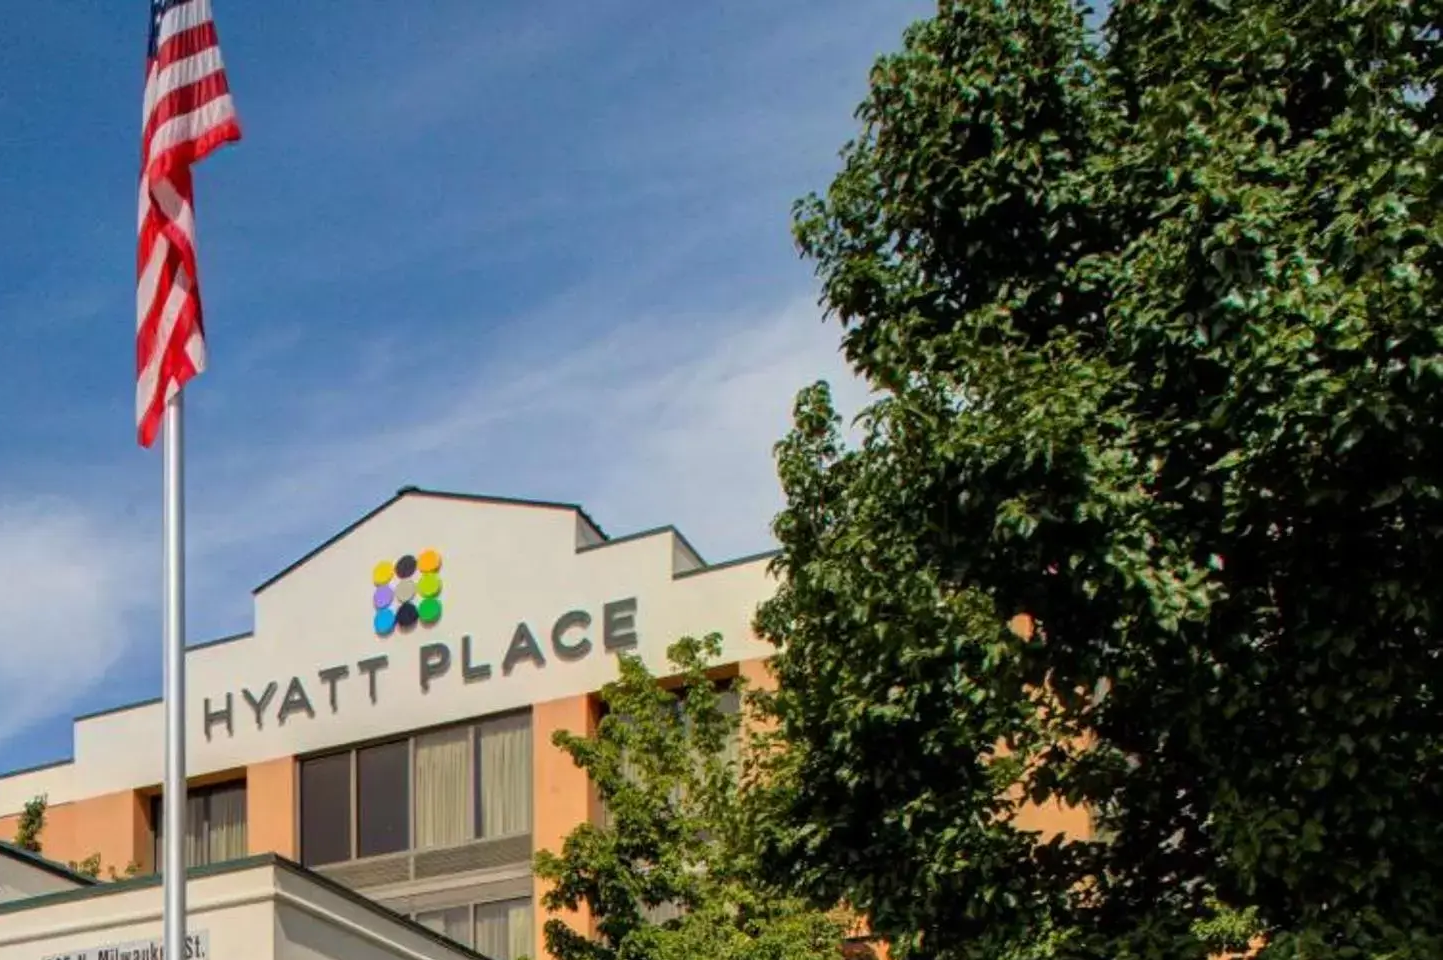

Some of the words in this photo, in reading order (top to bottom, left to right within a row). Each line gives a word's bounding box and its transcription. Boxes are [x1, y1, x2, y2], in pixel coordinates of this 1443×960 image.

[203, 656, 389, 742] HYATT
[419, 597, 638, 694] PLACE
[184, 935, 206, 960] St.
